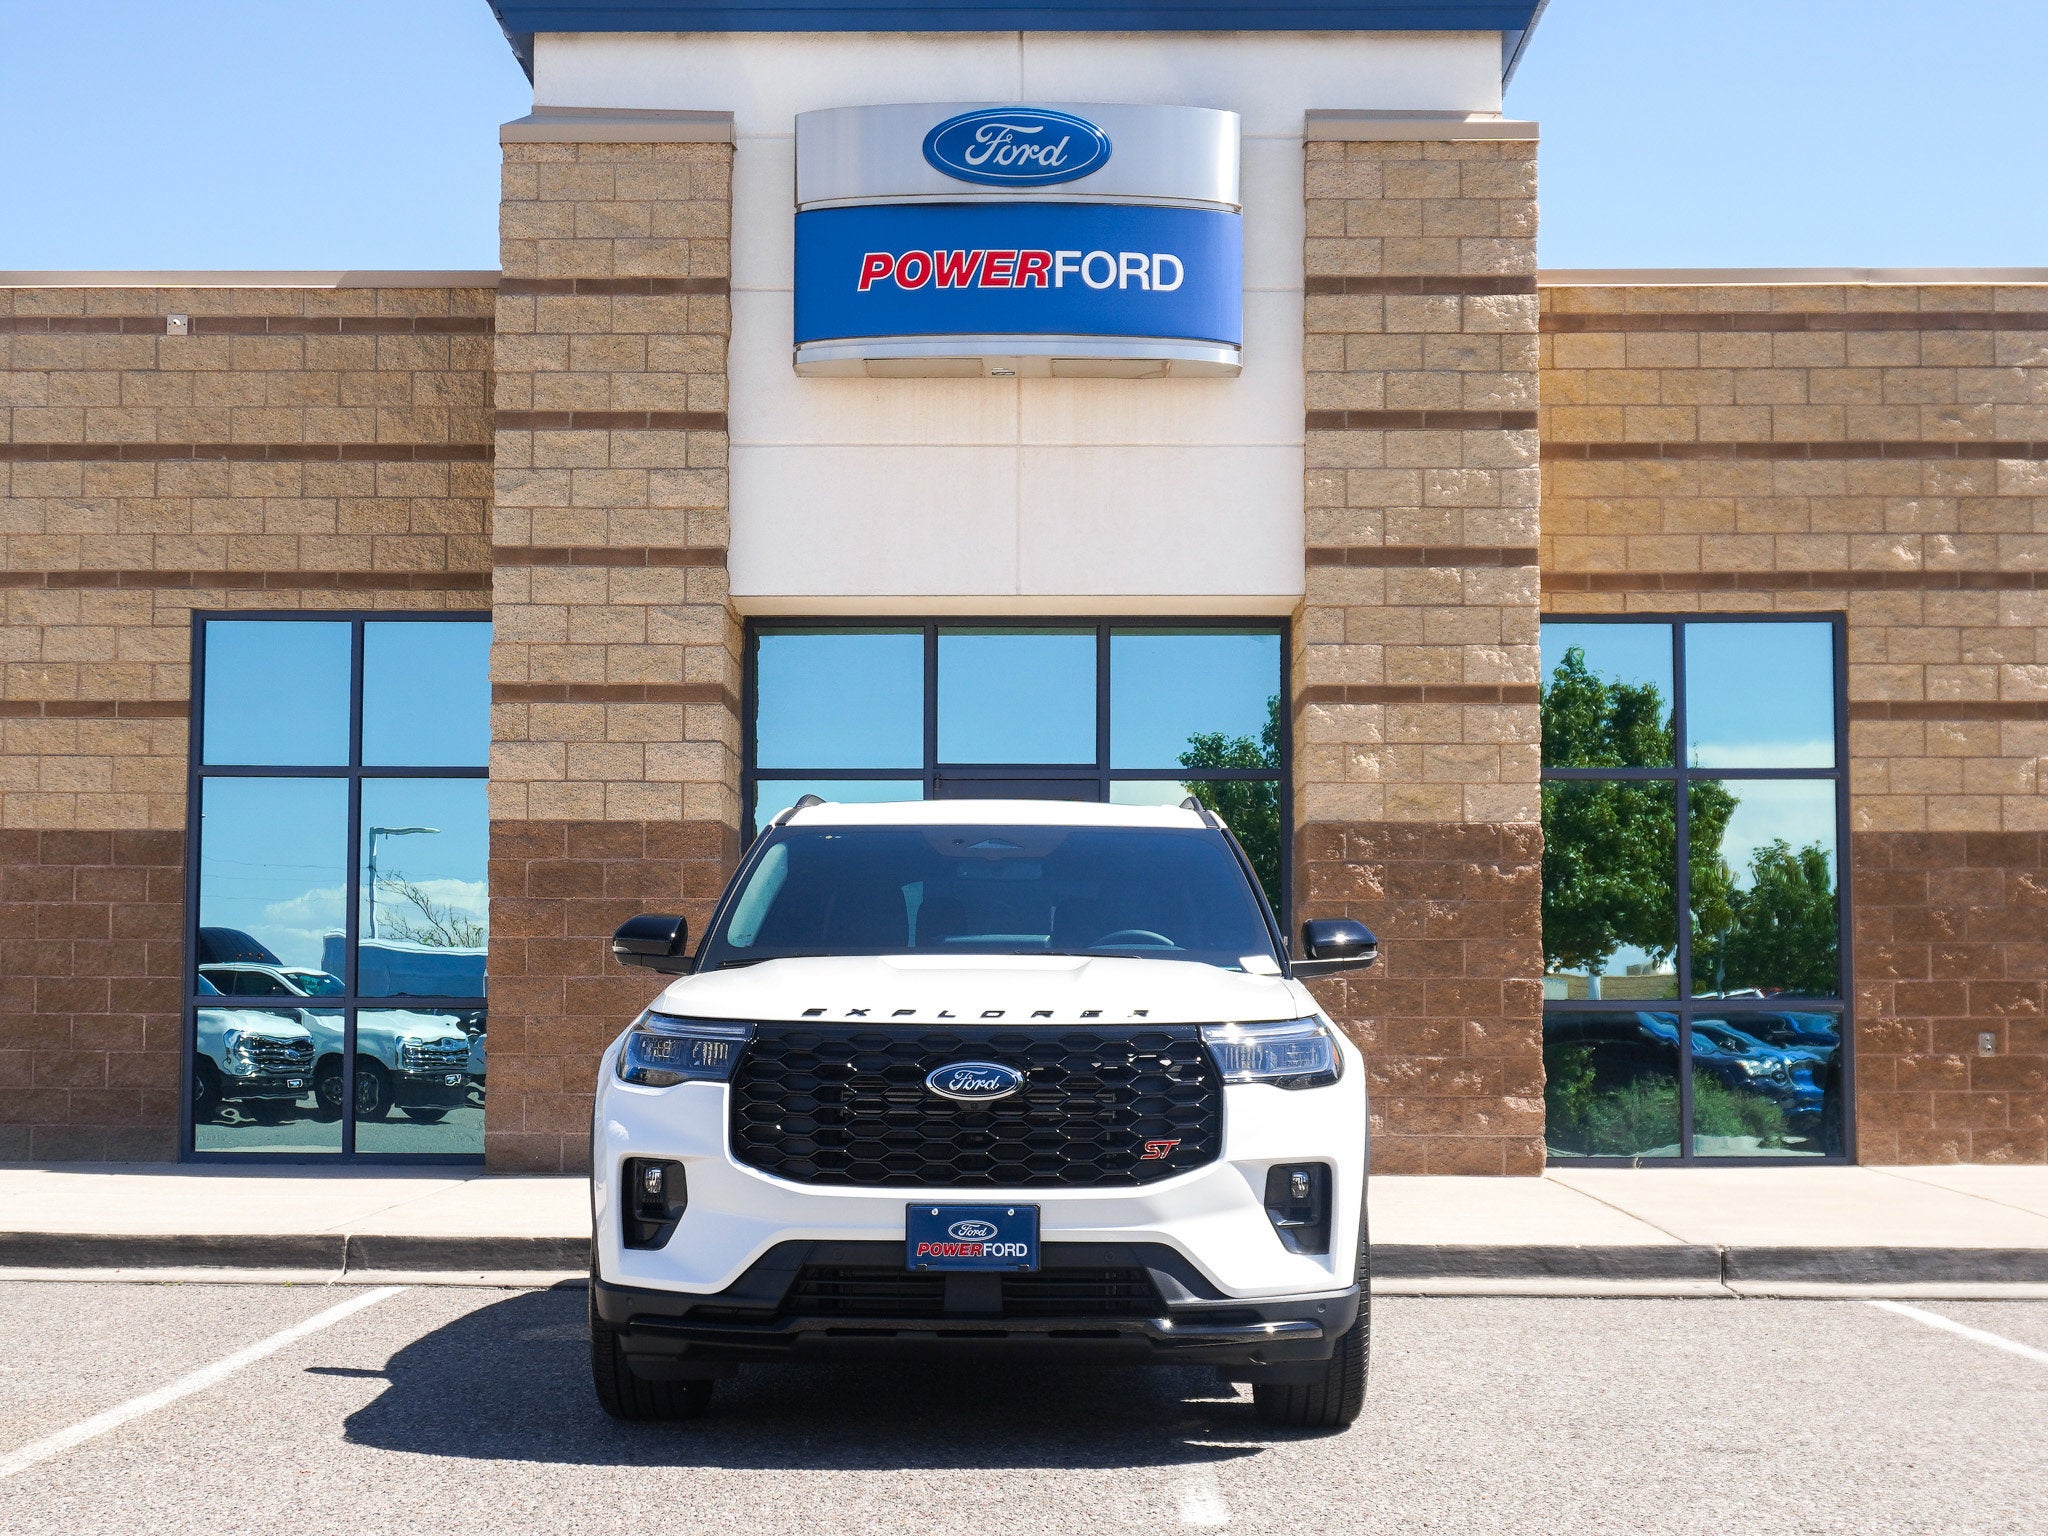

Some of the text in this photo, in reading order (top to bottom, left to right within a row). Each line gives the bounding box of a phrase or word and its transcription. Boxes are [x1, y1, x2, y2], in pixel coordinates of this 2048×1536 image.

[965, 123, 1068, 167] Ford
[857, 249, 1184, 291] POWERFORD
[801, 1008, 1150, 1018] EXPLORER
[949, 1070, 1000, 1091] Ford
[1140, 1139, 1181, 1160] ST
[958, 1224, 987, 1237] Ford
[917, 1242, 1028, 1257] POWERFORD
